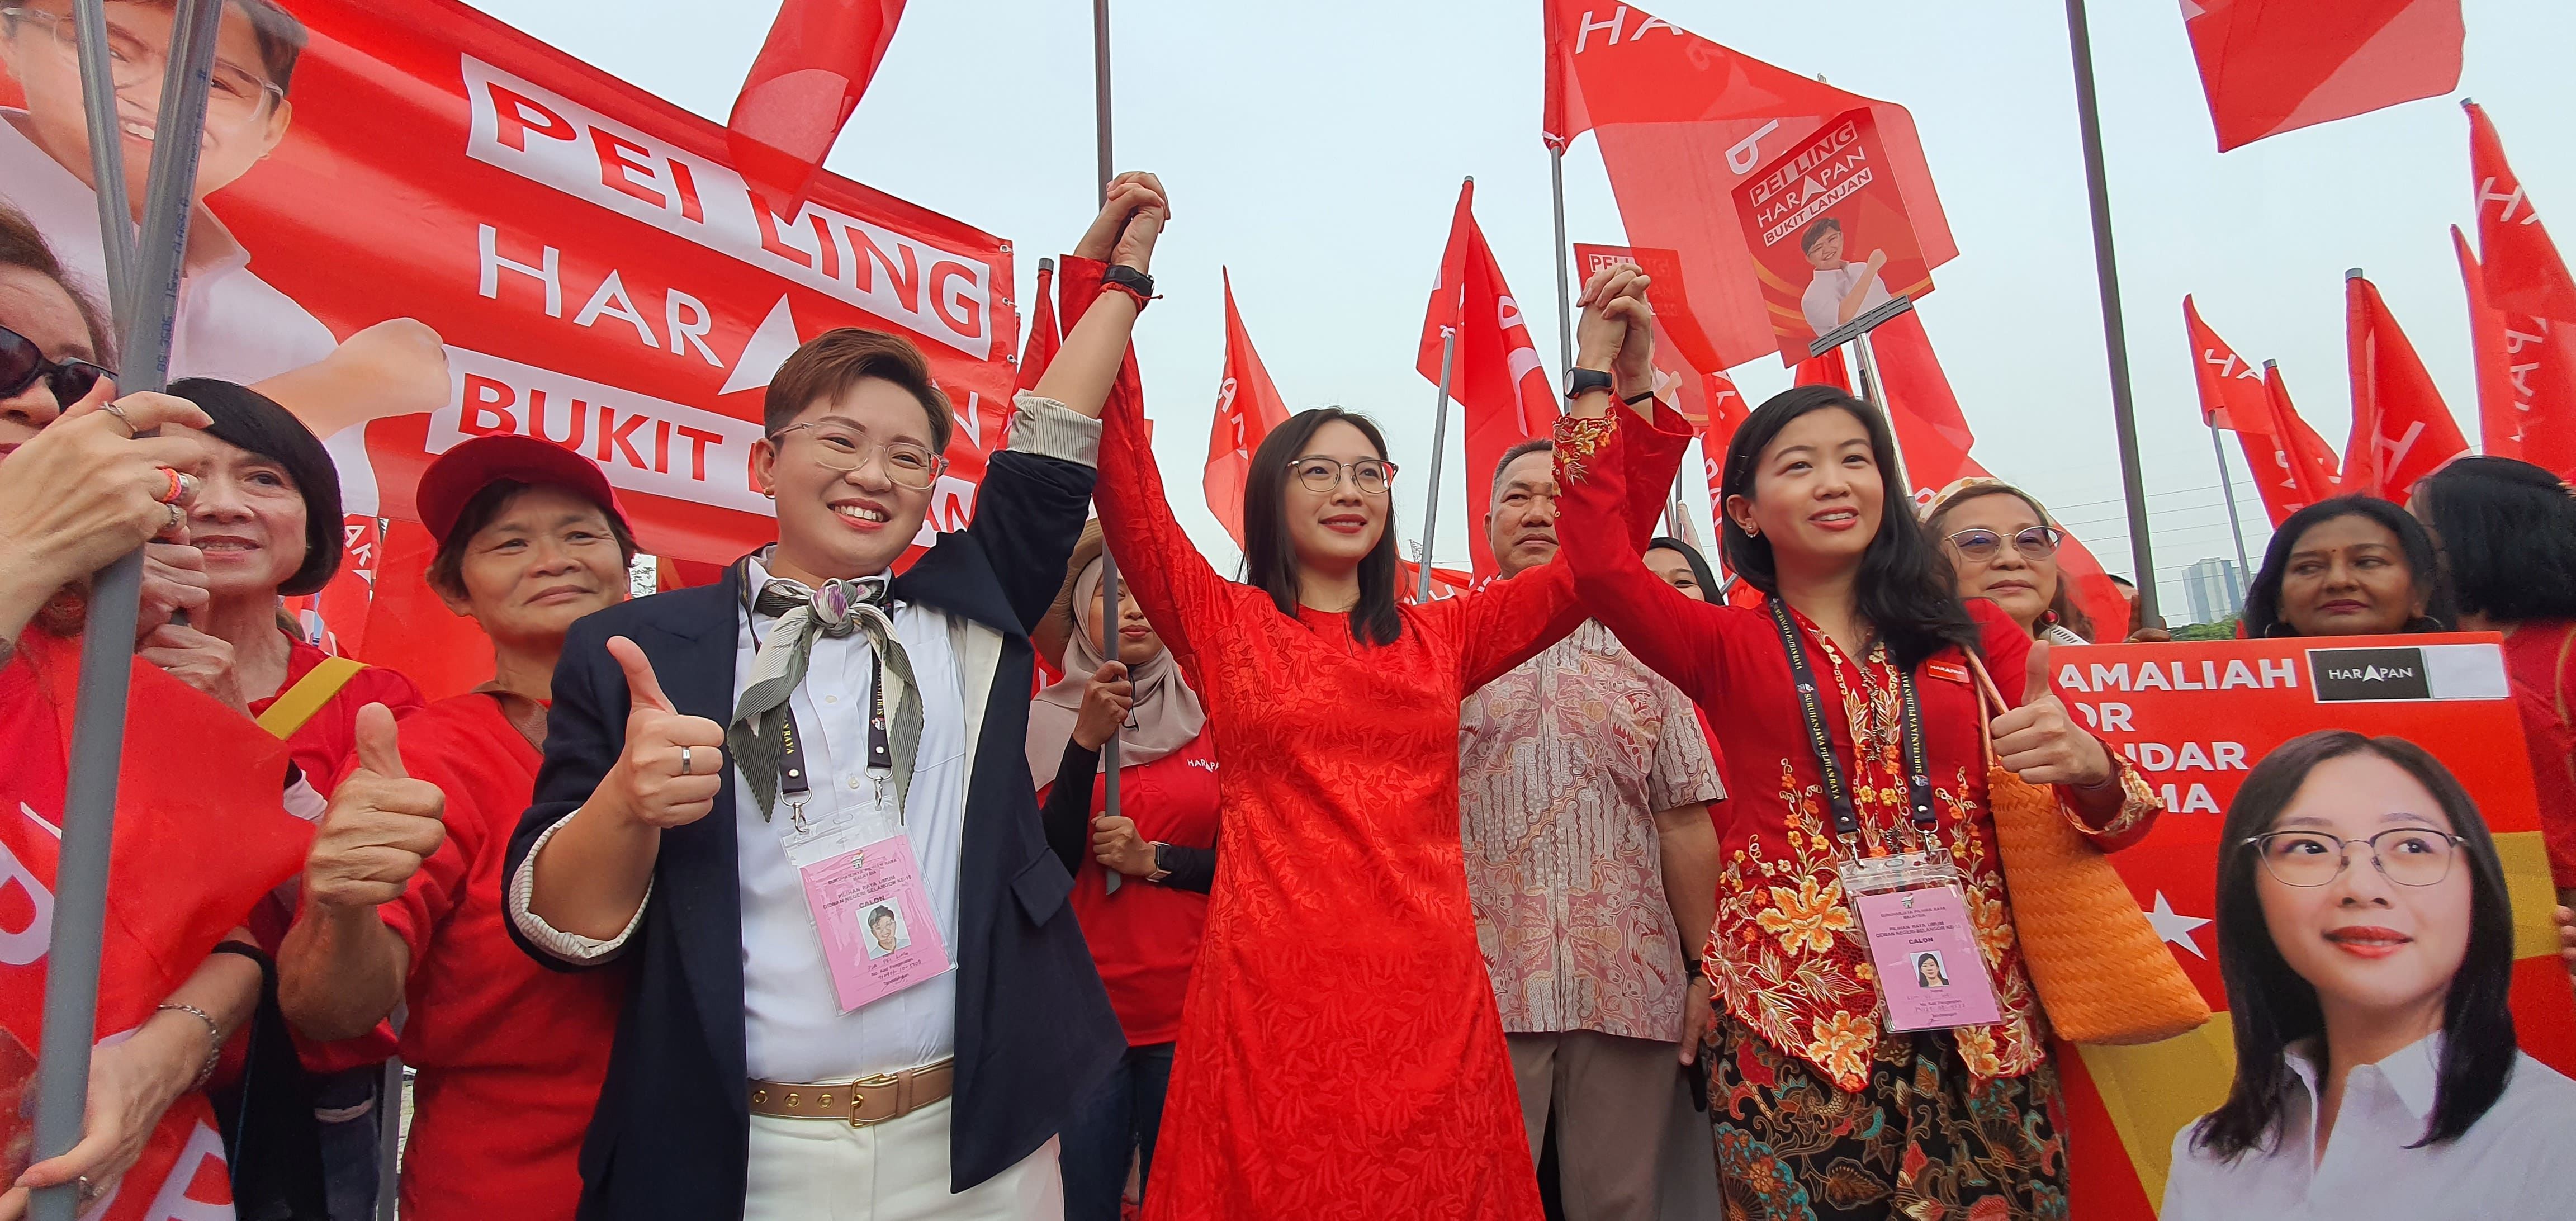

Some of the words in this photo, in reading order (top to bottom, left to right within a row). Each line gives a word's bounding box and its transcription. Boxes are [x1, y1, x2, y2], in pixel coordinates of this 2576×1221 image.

[1750, 169, 1788, 205] PEI
[1794, 124, 1855, 176] LING
[1757, 145, 1866, 228] HARAPAN
[486, 81, 704, 224] PEI
[747, 189, 982, 338] LING
[1765, 211, 1805, 244] BUKIT
[1809, 170, 1870, 215] LANJAN
[458, 373, 723, 481] BUKIT
[2058, 657, 2298, 692] AMALIAH
[2328, 664, 2413, 682] HARAPAN
[783, 730, 794, 754] RAYA
[1805, 693, 1825, 746] SURUHANJAYA
[1829, 779, 1841, 799] RAYA
[1910, 718, 1923, 773] SURUHANJAYA
[844, 890, 866, 902] NEGERI
[858, 895, 886, 908] CALON
[861, 881, 877, 890] RAYA
